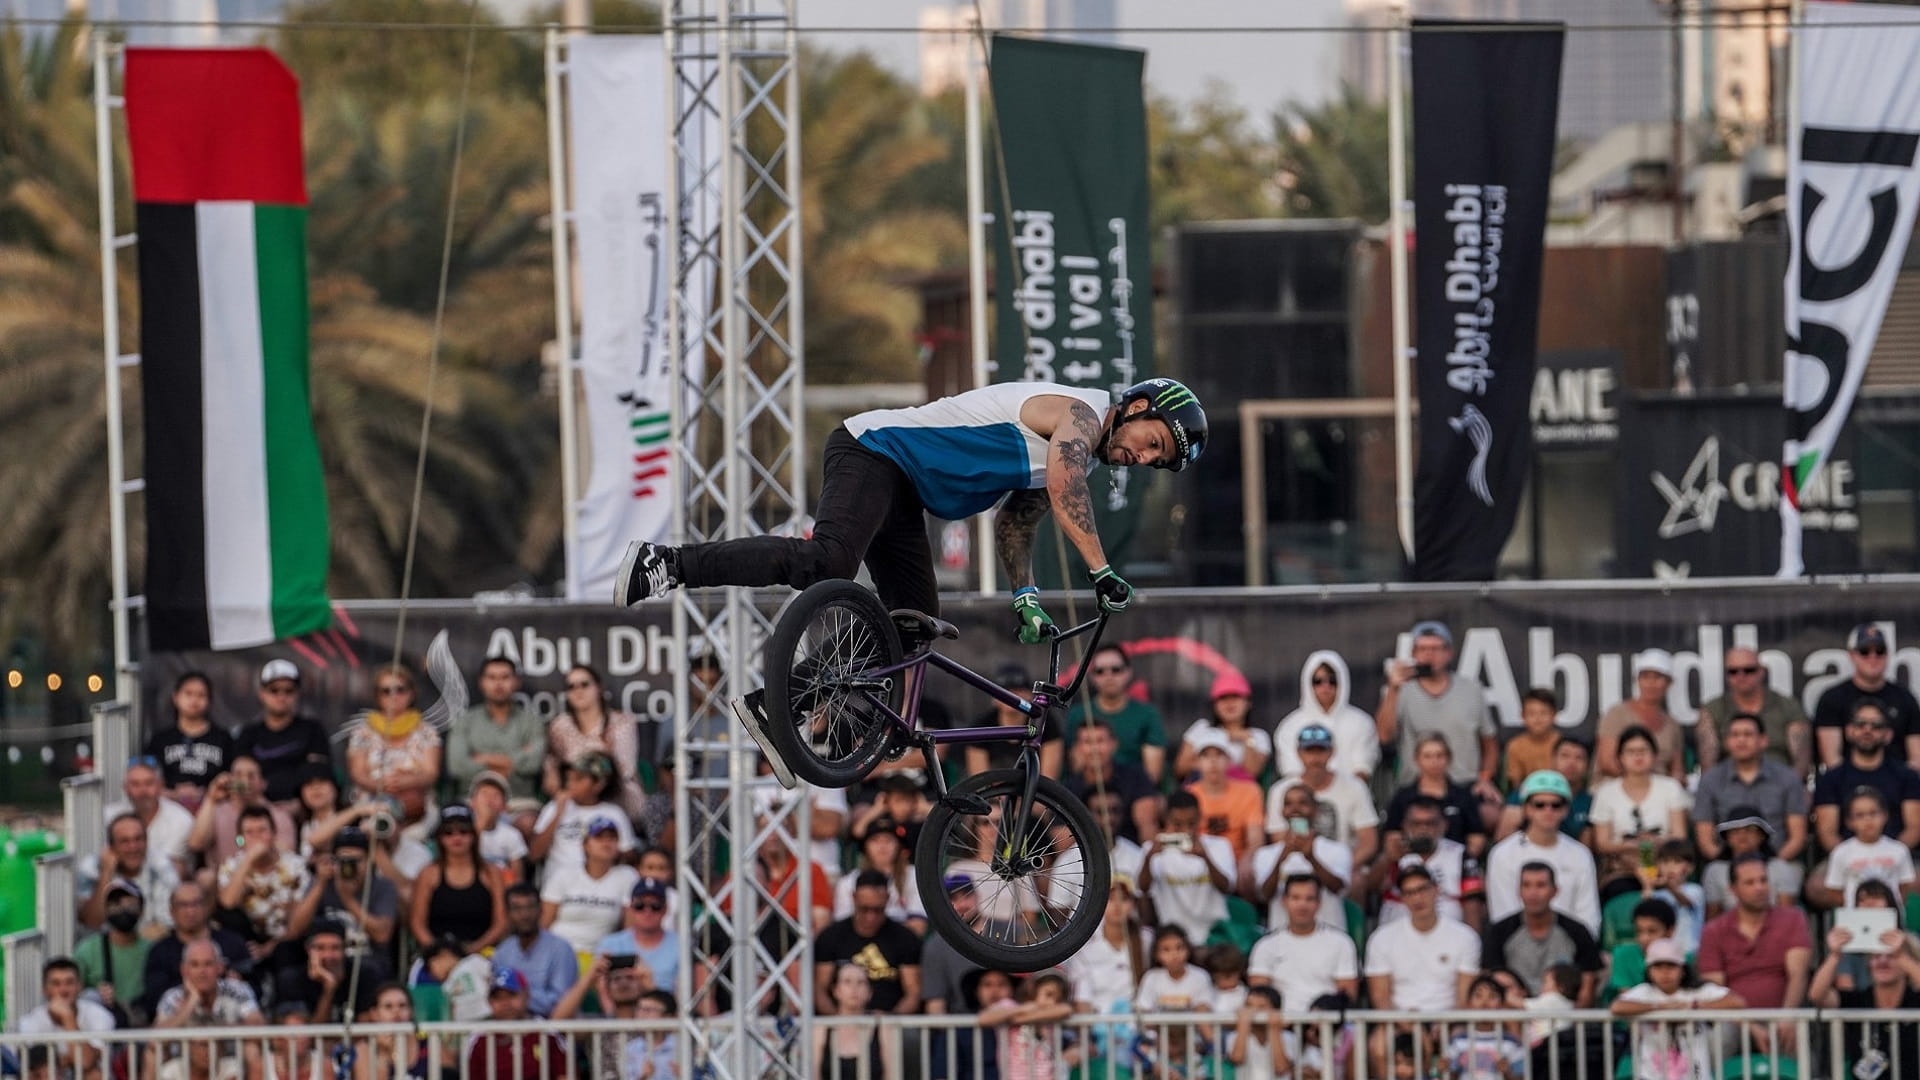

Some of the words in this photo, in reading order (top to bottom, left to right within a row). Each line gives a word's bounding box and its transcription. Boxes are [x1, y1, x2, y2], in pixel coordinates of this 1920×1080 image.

[1013, 210, 1055, 331] dhabi
[1446, 184, 1482, 301] Dhabi
[1018, 336, 1056, 383] bu
[1446, 312, 1484, 394] Abu
[1729, 461, 1853, 511] CRNE
[486, 626, 592, 677] Abu
